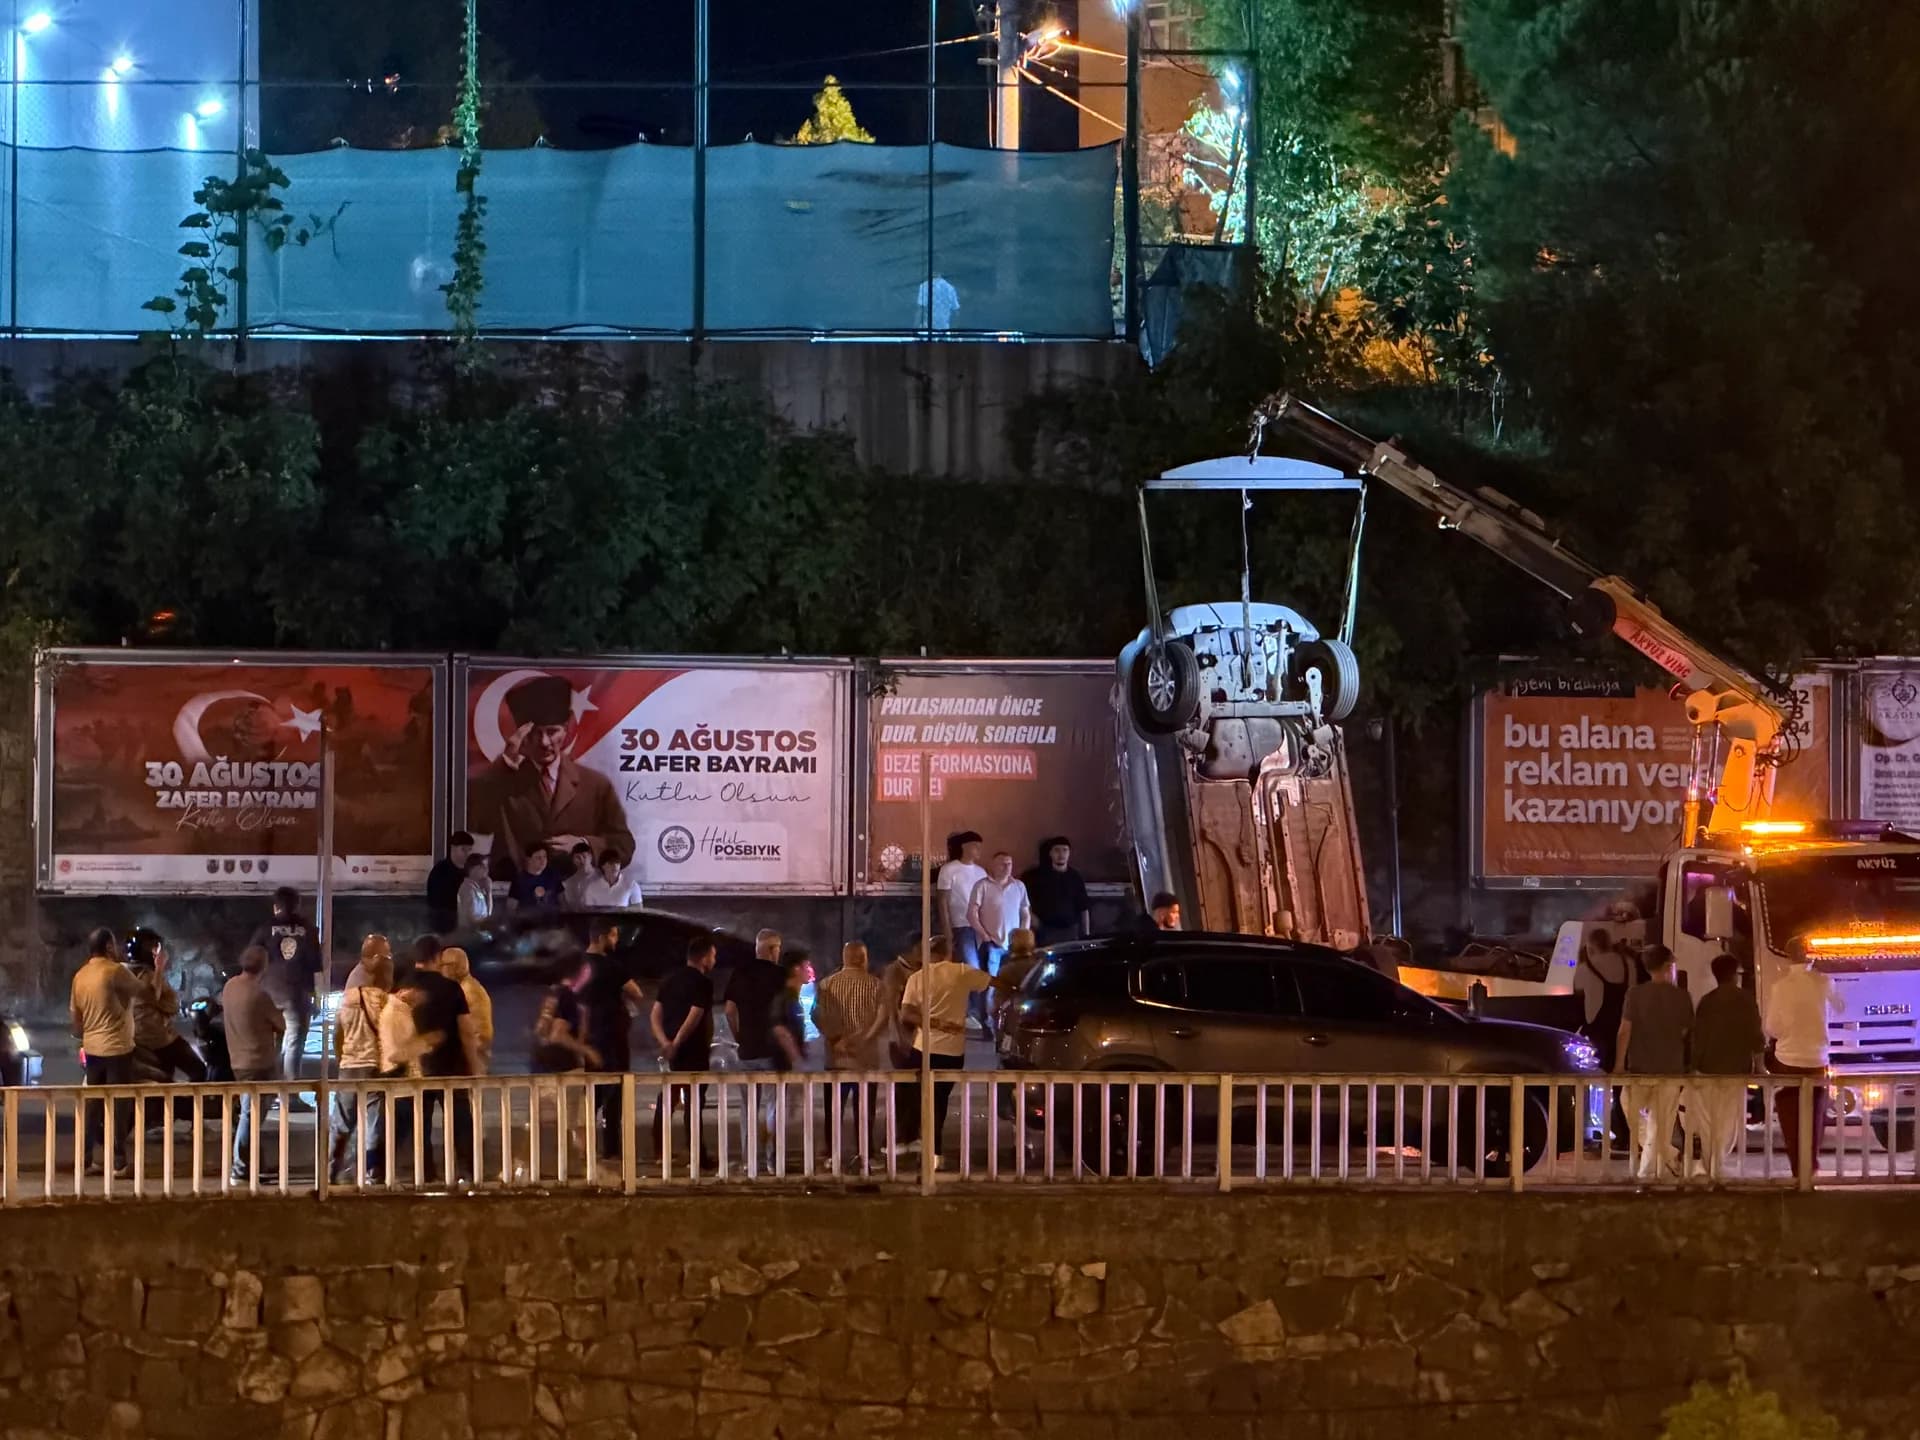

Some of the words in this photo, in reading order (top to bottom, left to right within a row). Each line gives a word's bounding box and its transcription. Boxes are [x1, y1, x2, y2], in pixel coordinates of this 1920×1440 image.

[880, 697, 997, 718] PAYLAŞMADAN
[1000, 695, 1043, 716] ÖNCE
[620, 728, 660, 751] 30
[668, 723, 817, 752] AĞUSTOS
[880, 724, 918, 745] DUR,
[921, 722, 979, 746] DÜŞÜN,
[982, 725, 1057, 744] SORGULA
[1504, 714, 1549, 748] bu
[1558, 715, 1656, 750] alana
[144, 761, 184, 788] 30
[189, 755, 321, 788] AĞUSTOS
[619, 755, 700, 773] ZAFER
[707, 755, 817, 774] BAYRAMI
[884, 754, 1033, 775] DEZEFORMASYONA
[1504, 752, 1629, 787] reklam
[624, 781, 712, 803] Kutlu
[720, 782, 811, 803] Olsun
[883, 778, 913, 796] DUR
[918, 778, 942, 796] E!
[156, 791, 223, 808] ZAFER
[227, 791, 317, 809] BAYRAMI
[176, 801, 226, 832] Kutlu
[714, 845, 781, 856] POSBIYIK
